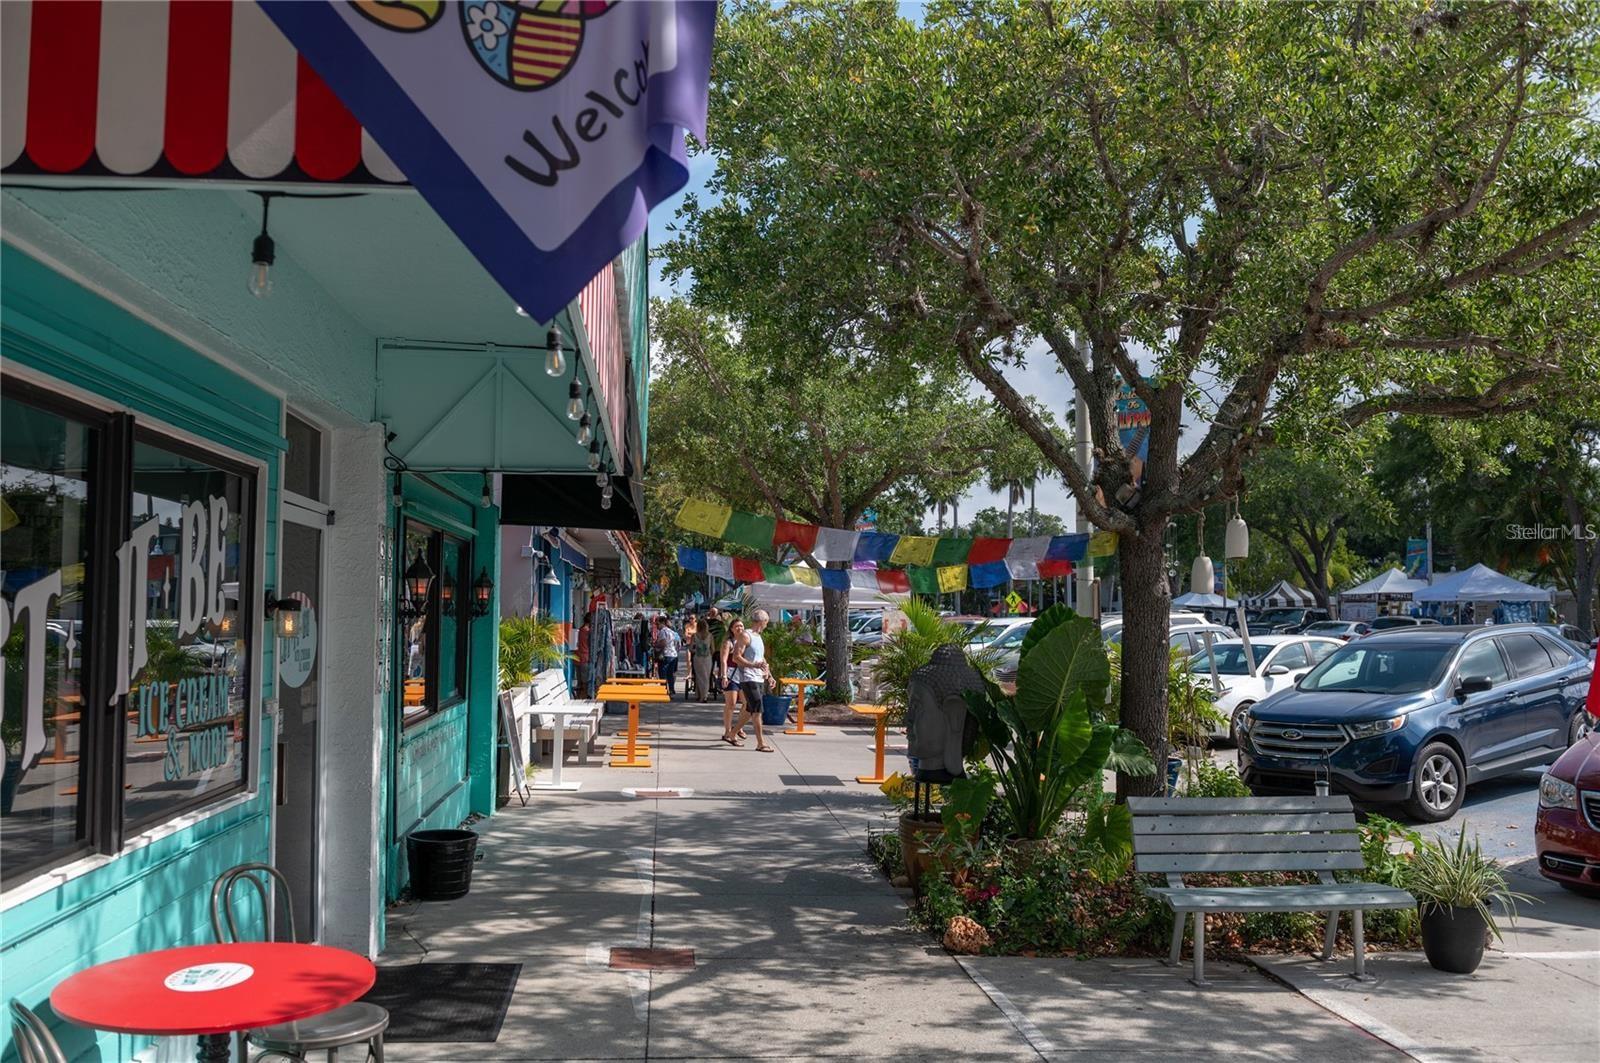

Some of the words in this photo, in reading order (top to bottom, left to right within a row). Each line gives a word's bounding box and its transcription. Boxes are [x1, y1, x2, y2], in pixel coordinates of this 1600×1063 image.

[177, 494, 229, 640] BE
[137, 680, 169, 738] ICE
[175, 674, 229, 731] CREAM
[164, 726, 185, 781] &
[187, 724, 229, 776] MORE
